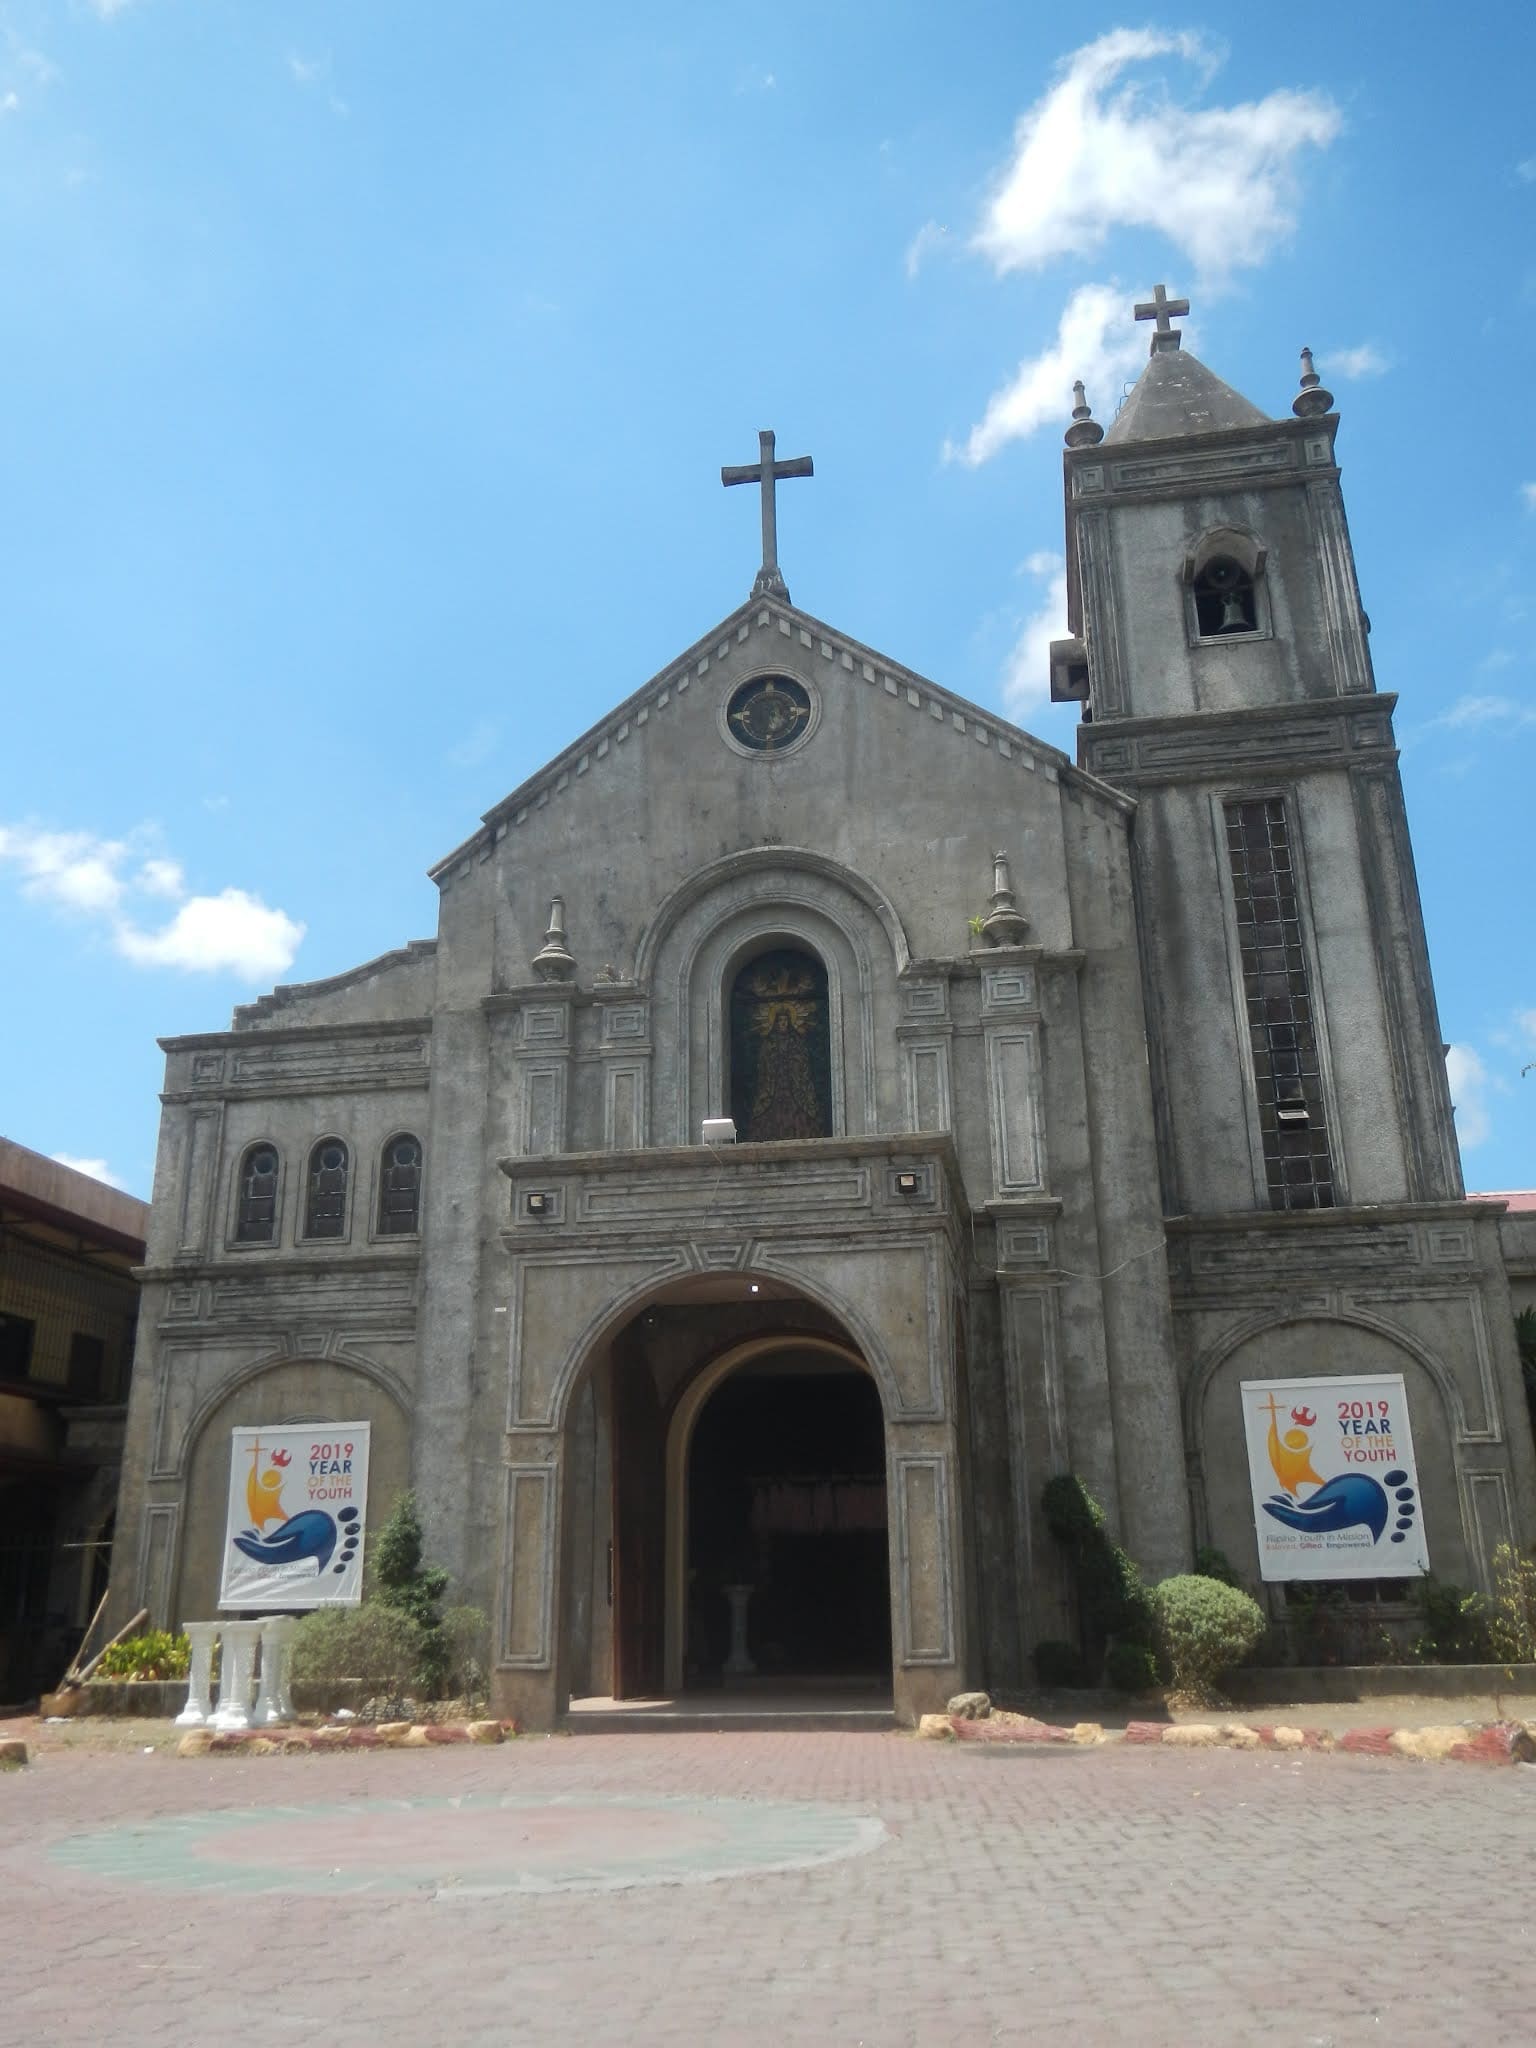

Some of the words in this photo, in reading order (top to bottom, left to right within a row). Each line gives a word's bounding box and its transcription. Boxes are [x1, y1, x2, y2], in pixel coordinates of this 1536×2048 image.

[1338, 1401, 1389, 1419] 2019
[1338, 1419, 1391, 1435] YEAR
[1341, 1437, 1361, 1449] OF
[1367, 1435, 1393, 1448] THE
[310, 1443, 354, 1460] 2019
[1344, 1449, 1396, 1462] YOUTH
[309, 1460, 352, 1475] YEAR
[308, 1476, 325, 1487] OF
[330, 1475, 353, 1486] THE
[309, 1488, 352, 1500] YOUTH
[1299, 1533, 1324, 1542] Youth
[1327, 1533, 1335, 1541] in
[1336, 1532, 1369, 1541] Mission
